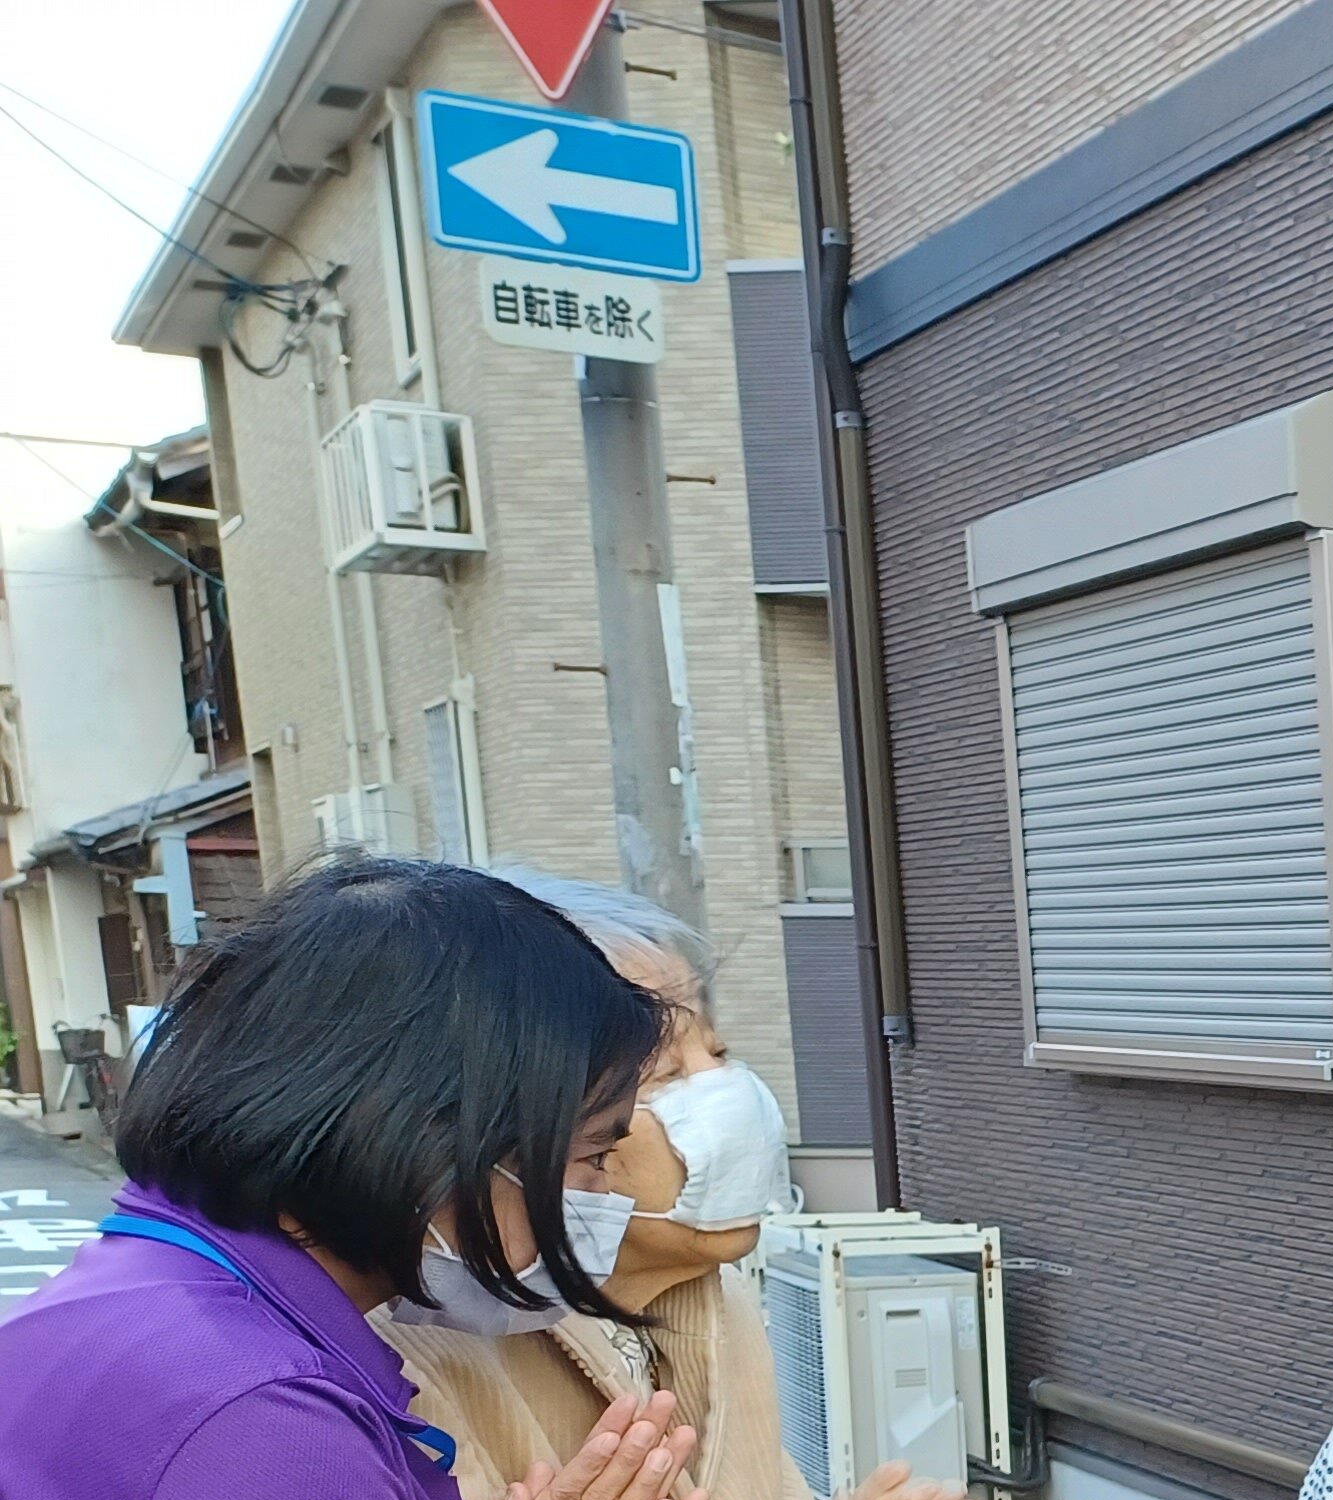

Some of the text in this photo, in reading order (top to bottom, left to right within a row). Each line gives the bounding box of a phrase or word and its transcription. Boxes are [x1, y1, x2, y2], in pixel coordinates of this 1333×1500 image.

[493, 280, 654, 342] 自転車を除く
